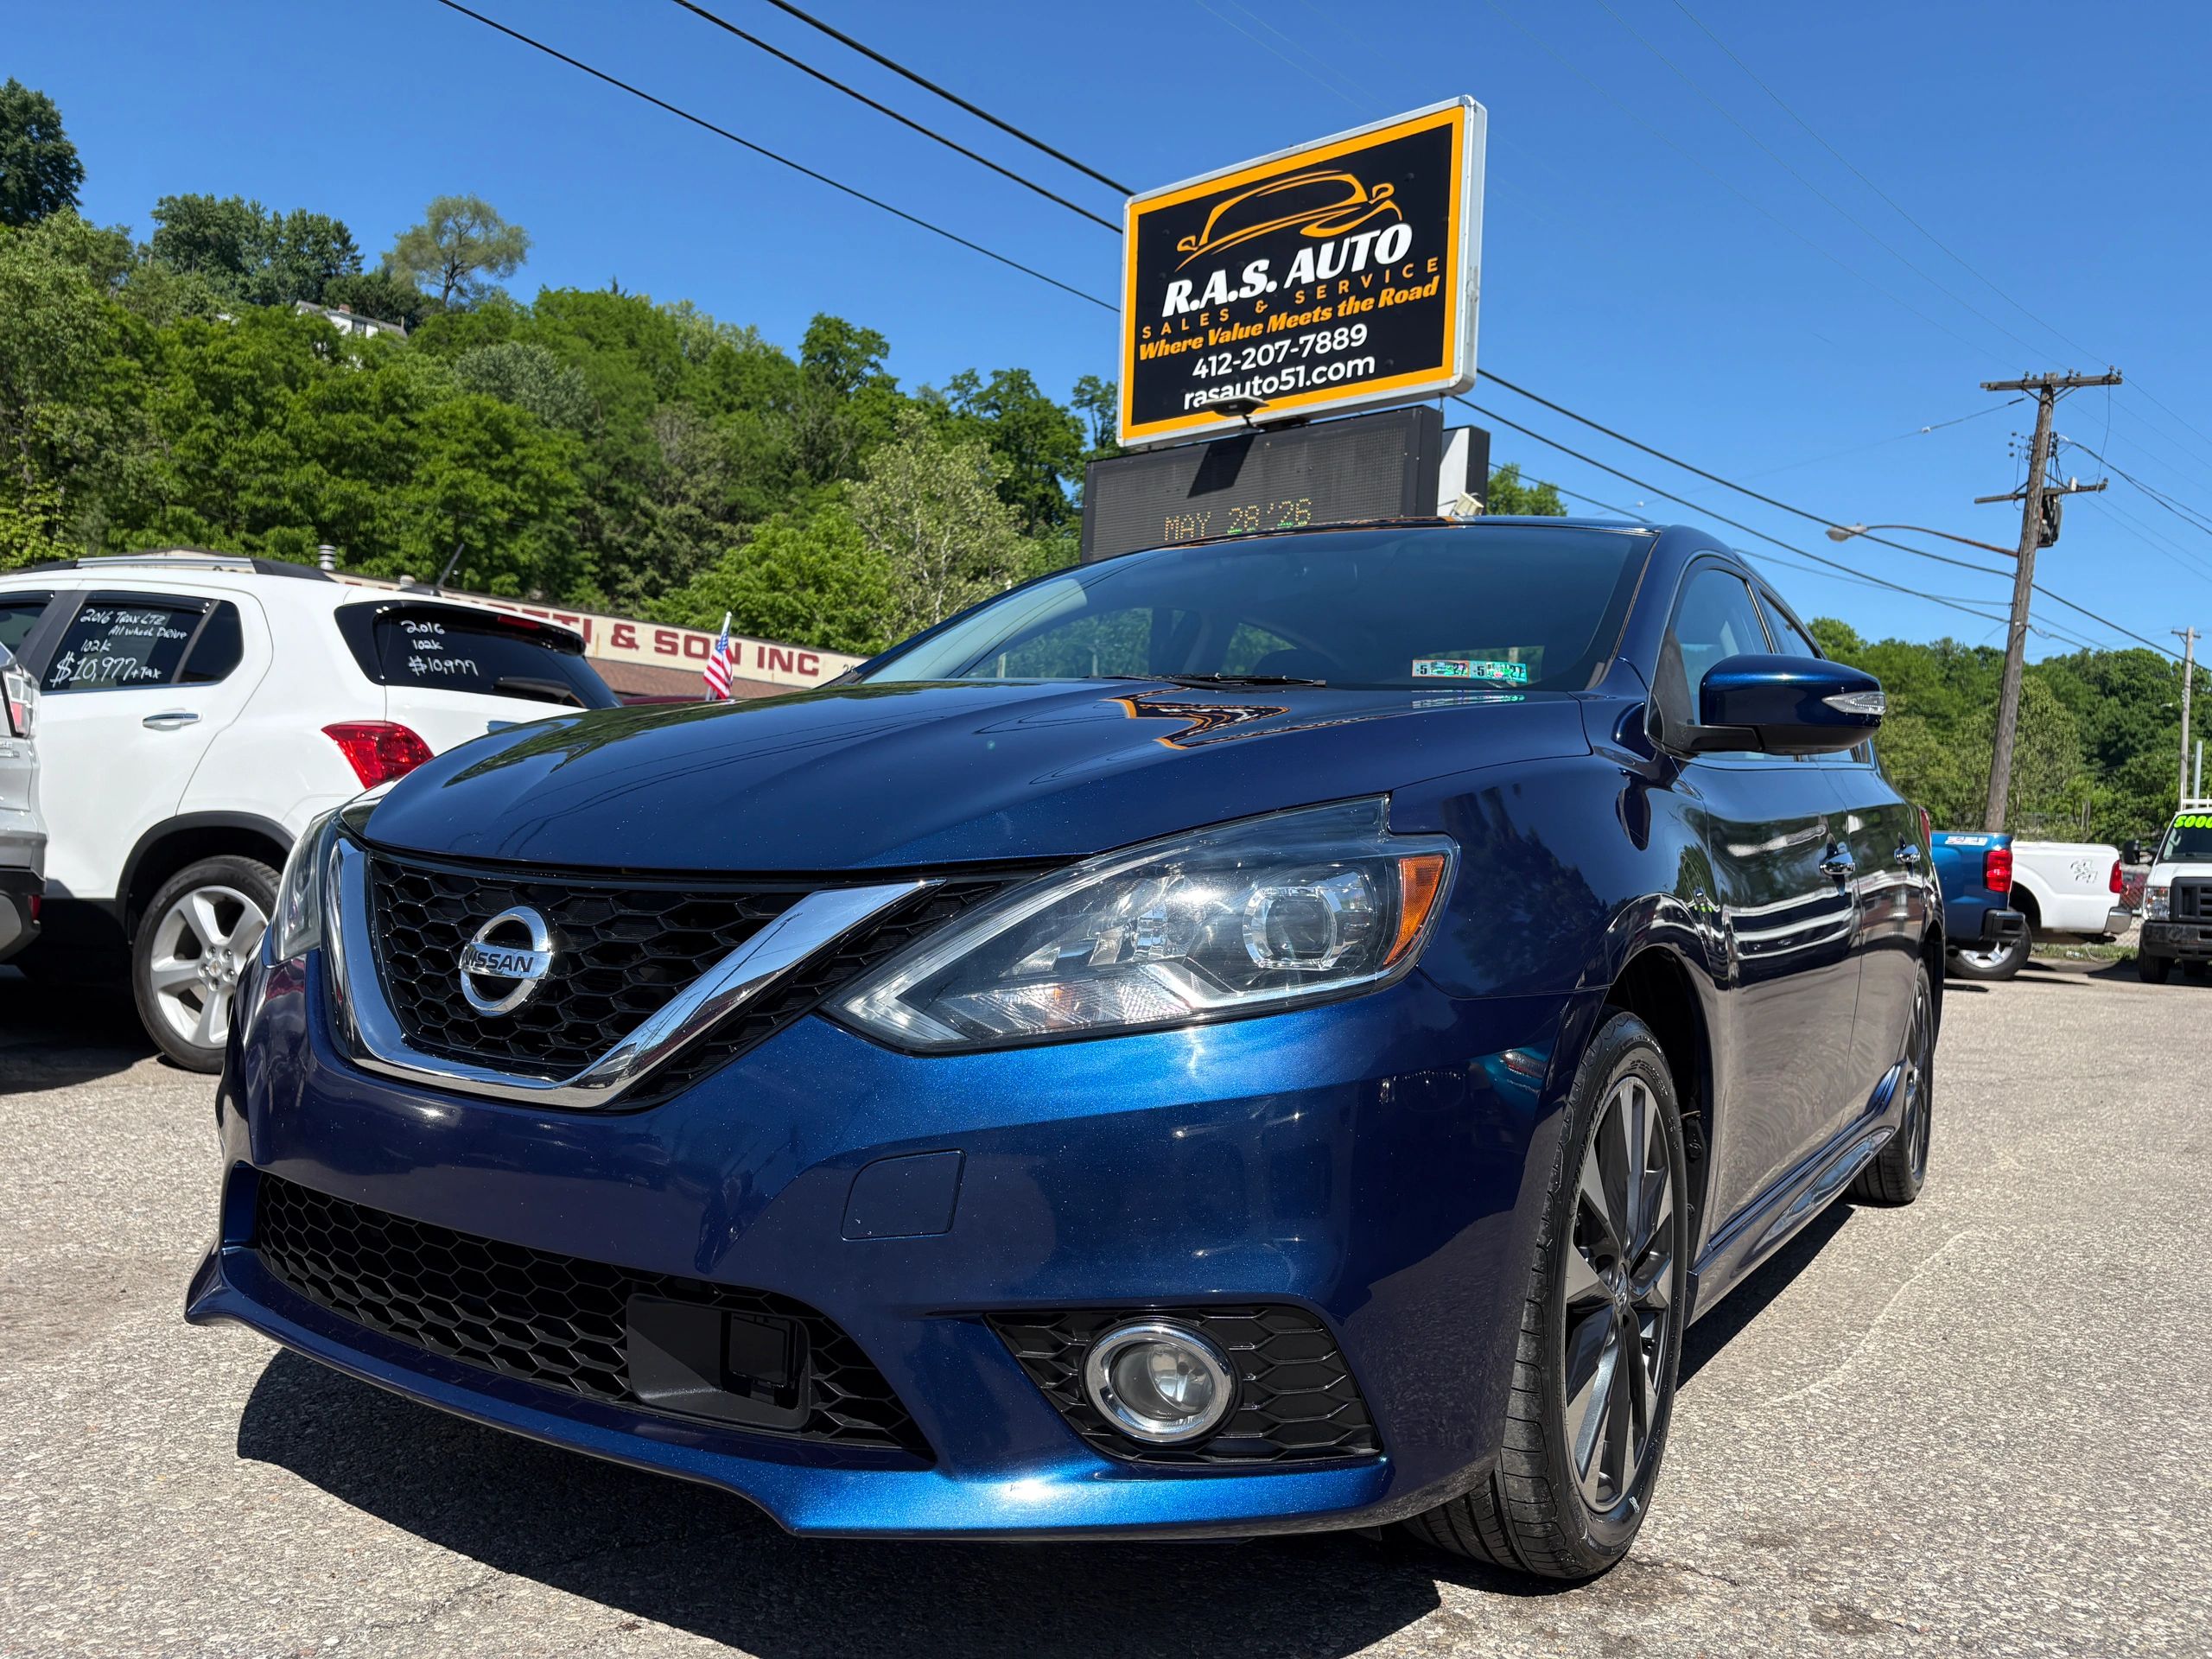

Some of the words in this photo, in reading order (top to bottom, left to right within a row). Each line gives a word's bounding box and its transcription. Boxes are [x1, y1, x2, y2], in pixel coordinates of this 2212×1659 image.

[1162, 258, 1278, 317] R.A.S.
[1283, 223, 1413, 289] AUTO
[1140, 336, 1204, 360] Where
[1208, 322, 1264, 346] Value
[1267, 306, 1332, 333] Meets
[1337, 296, 1376, 317] the
[1378, 275, 1440, 308] Road
[1142, 308, 1229, 339] SALES
[1255, 300, 1268, 313] &
[1294, 257, 1439, 304] SERVICE
[1192, 323, 1368, 378] 412-207-7889
[1184, 356, 1376, 410] rasauto51.com
[1165, 512, 1211, 540] MAY
[1227, 505, 1261, 534] 28
[80, 608, 114, 624] 2016
[401, 620, 445, 635] 2016
[49, 650, 137, 689] $10,977
[611, 623, 639, 651] &
[757, 645, 820, 677] INC
[461, 950, 534, 973] NISSAN
